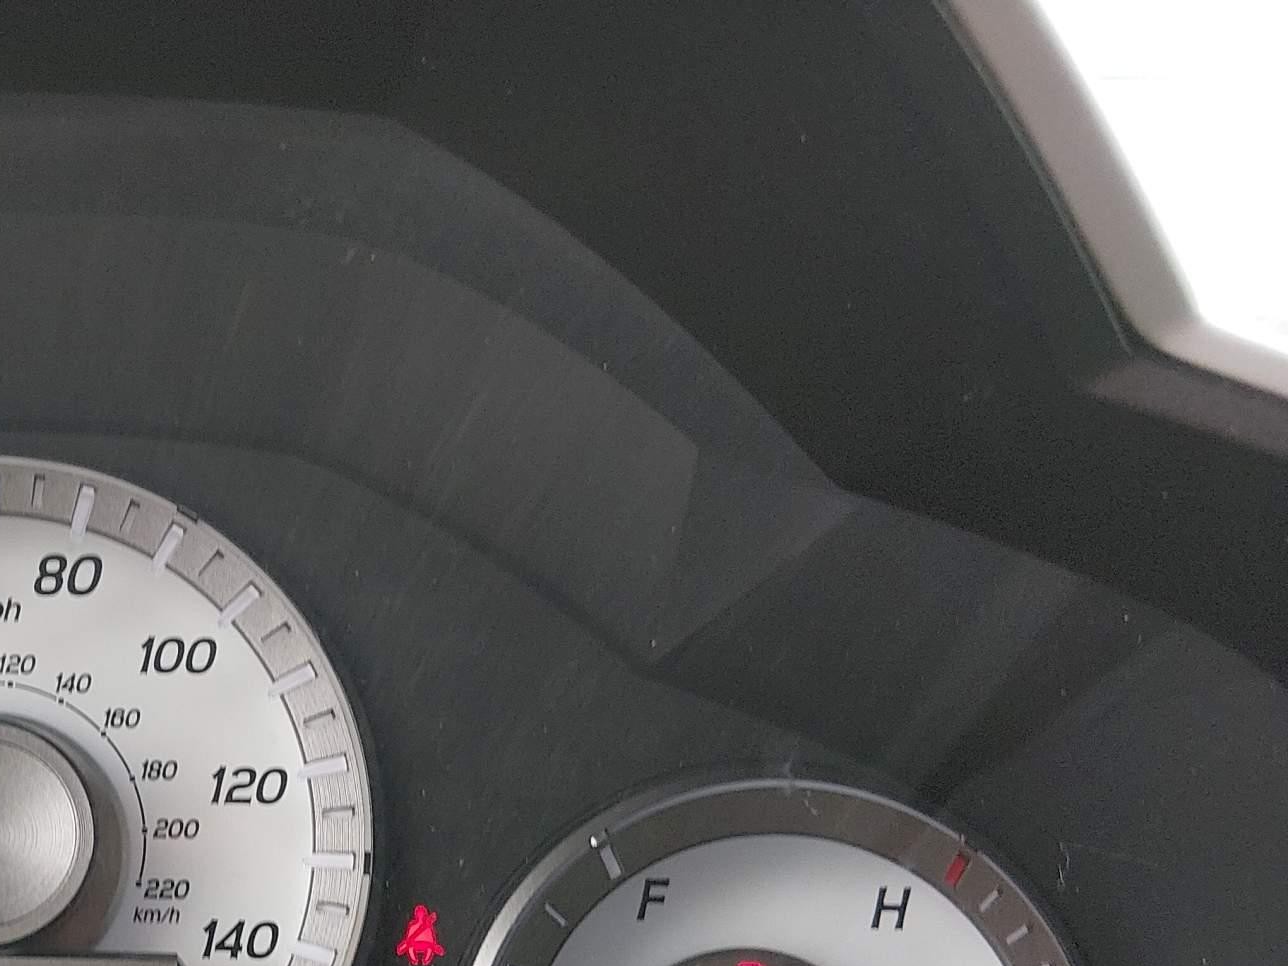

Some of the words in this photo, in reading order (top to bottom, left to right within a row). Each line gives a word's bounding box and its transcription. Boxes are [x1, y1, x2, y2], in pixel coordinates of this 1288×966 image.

[35, 555, 102, 595] 80
[0, 655, 35, 675] 120
[140, 637, 216, 673] 100
[56, 674, 91, 695] 140
[104, 708, 140, 729] 160
[141, 760, 177, 781] 180
[211, 767, 287, 805] 120
[153, 819, 199, 840] 200
[144, 879, 190, 900] 220
[637, 878, 670, 920] F
[133, 904, 181, 926] km/h
[870, 887, 911, 929] H
[202, 920, 278, 960] 140
